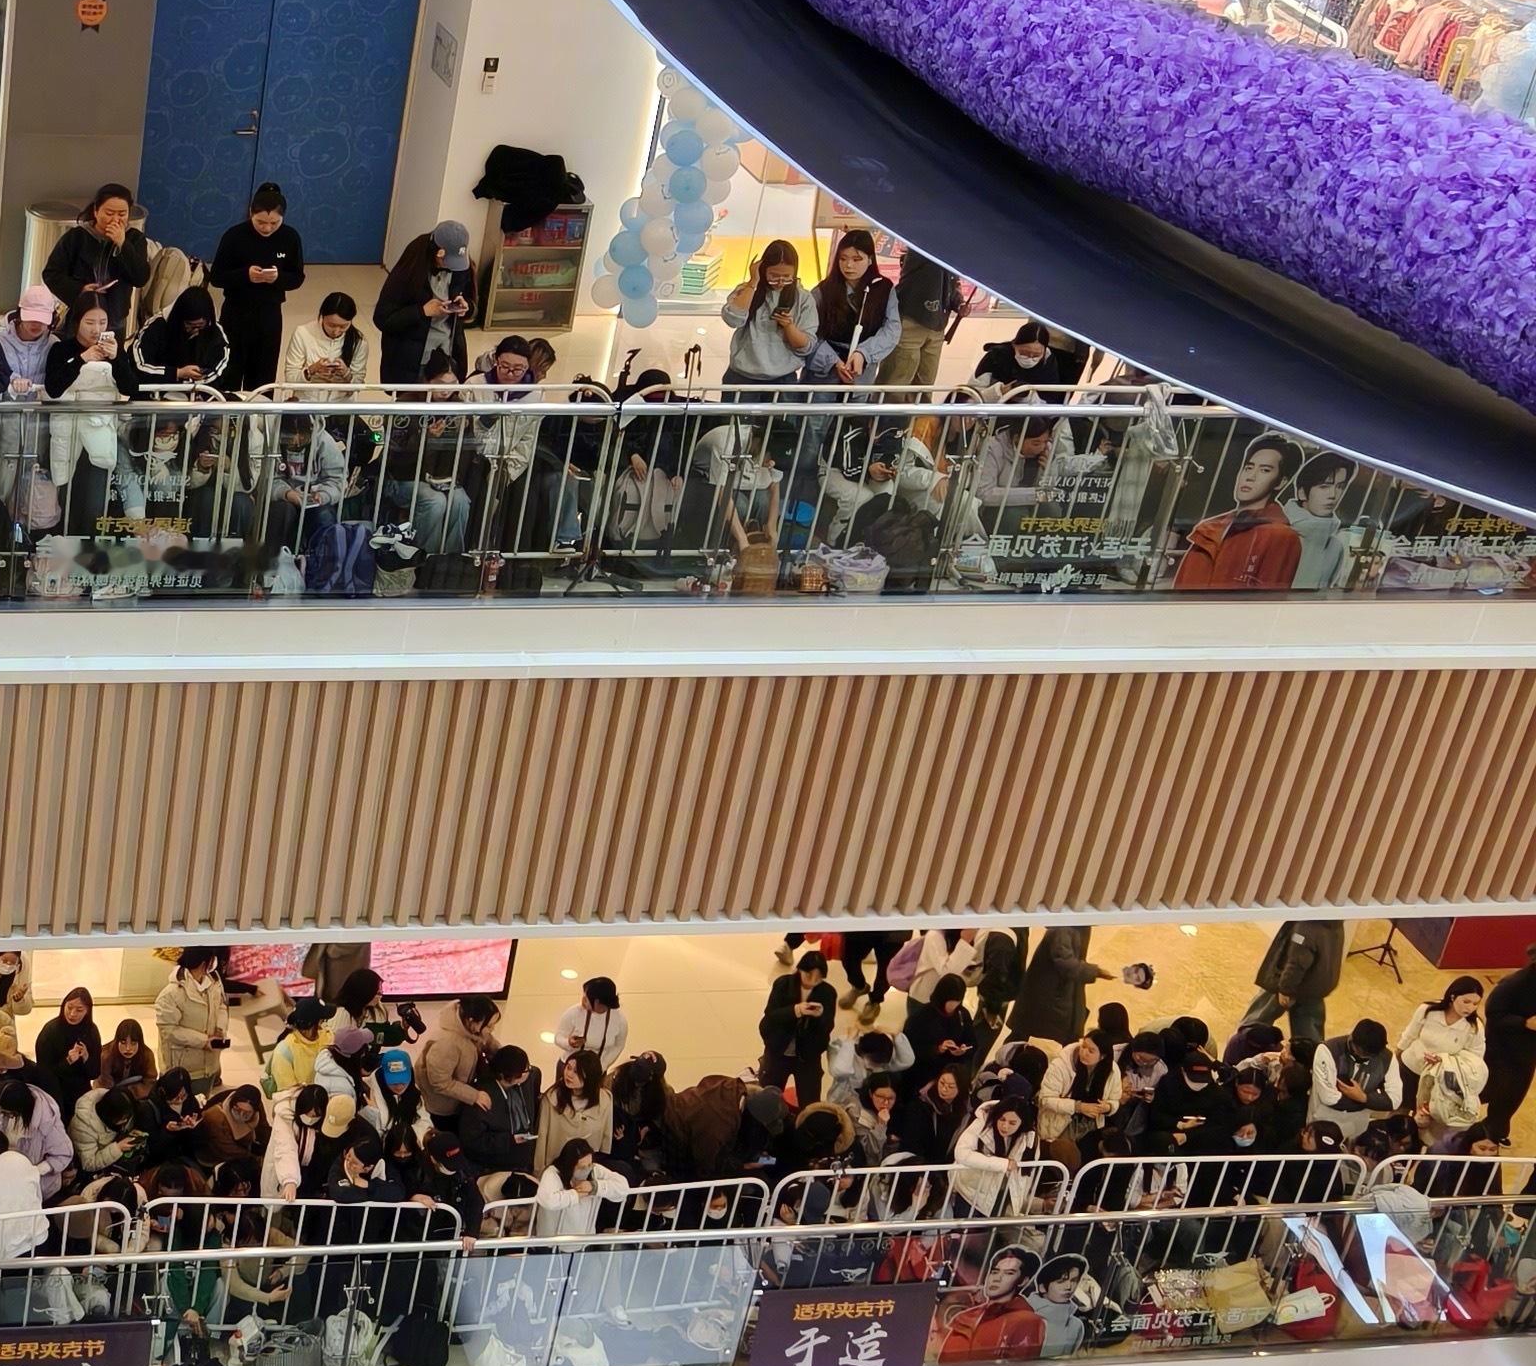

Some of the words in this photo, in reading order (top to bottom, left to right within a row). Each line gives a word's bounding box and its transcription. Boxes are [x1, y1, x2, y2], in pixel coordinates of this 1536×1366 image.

[793, 1299, 896, 1322] 适界夹克节
